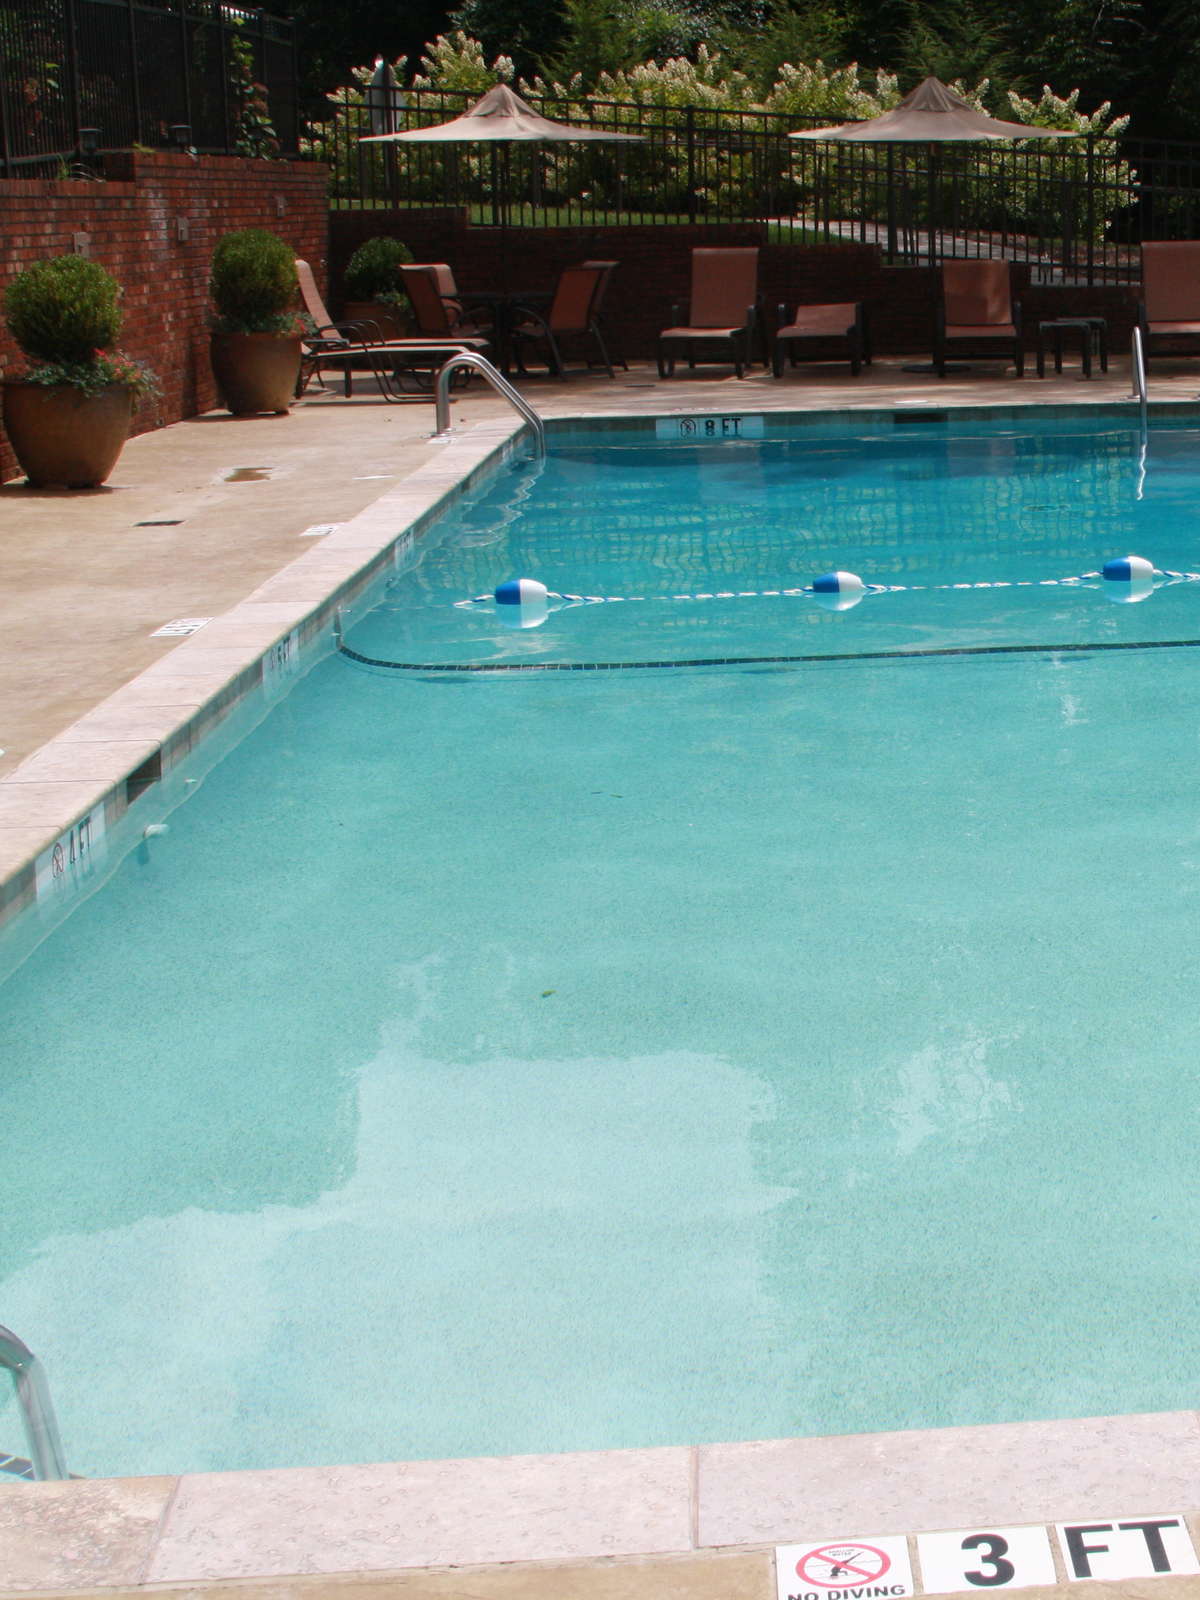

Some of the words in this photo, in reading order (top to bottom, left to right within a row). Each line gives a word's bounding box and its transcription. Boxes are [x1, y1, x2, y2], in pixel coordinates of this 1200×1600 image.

[961, 1533, 1015, 1587] 3
[1063, 1519, 1179, 1578] FT
[788, 1592, 819, 1600] NO
[828, 1585, 905, 1600] DIVING
